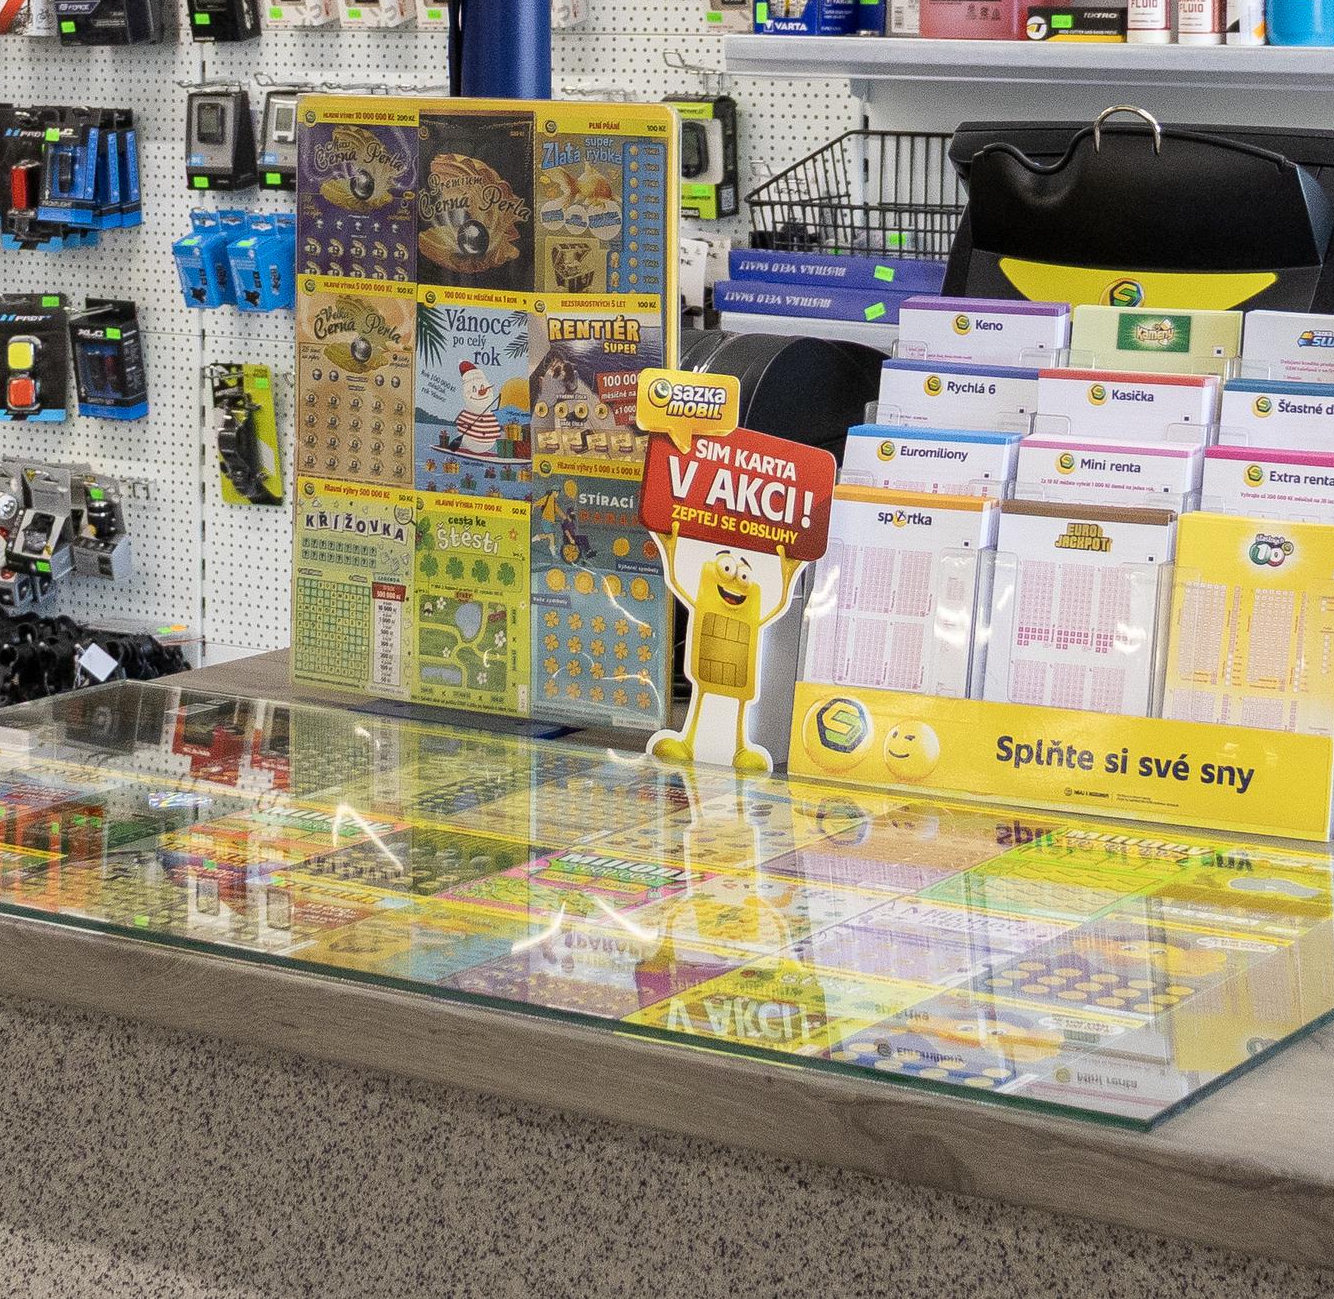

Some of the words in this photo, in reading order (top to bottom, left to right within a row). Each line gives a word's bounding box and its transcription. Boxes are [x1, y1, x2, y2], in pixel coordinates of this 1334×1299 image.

[1179, 3, 1204, 13] FLUID
[774, 22, 808, 31] VARTA
[363, 112, 374, 120] 000
[585, 139, 613, 148] super
[315, 144, 357, 172] Černá
[363, 142, 406, 171] Perla
[542, 142, 581, 170] Zlatá
[586, 150, 622, 164] rybka
[429, 173, 483, 195] Premium
[419, 189, 470, 220] Černá
[479, 185, 531, 222] Perla
[444, 291, 453, 299] 100
[454, 292, 467, 300] 000
[314, 315, 355, 339] Černá
[363, 313, 401, 343] Perla
[445, 308, 512, 335] Vánoce
[547, 314, 640, 342] RENTIÉR
[975, 319, 1003, 331] Keno
[1136, 324, 1175, 341] Kameny
[453, 337, 464, 347] po
[467, 335, 486, 349] celý
[603, 341, 636, 354] SUPER
[474, 349, 501, 366] rok
[603, 375, 621, 387] 100
[947, 381, 985, 395] Rychlá
[988, 384, 996, 394] 6
[671, 385, 726, 403] sazka
[1112, 389, 1154, 402] Kasička
[667, 400, 722, 420] MOBIL
[1278, 399, 1322, 415] Šťastné
[695, 439, 731, 465] SIM
[735, 450, 797, 481] KARTA
[900, 446, 968, 463] Euromiliony
[557, 462, 576, 470] Hlavní
[577, 464, 593, 474] výhry
[598, 465, 611, 473] 000
[621, 466, 633, 475] 000
[1081, 458, 1107, 470] Mini
[1110, 461, 1141, 473] renta
[1269, 471, 1301, 484] Extra
[324, 484, 341, 493] Hlavní
[342, 486, 359, 497] výhry
[359, 488, 370, 497] 500
[371, 489, 383, 498] 000
[668, 455, 699, 499] V
[705, 468, 796, 524] AKCI
[578, 492, 634, 508] STÍRACÍ
[305, 511, 405, 542] KŘÍŽOVKA
[448, 516, 473, 526] cesta
[476, 517, 486, 527] ke
[671, 504, 718, 527] ZEPTEJ
[721, 516, 737, 531] SE
[739, 520, 798, 545] OBSLUHY
[436, 522, 502, 554] Štěstí
[1068, 523, 1103, 537] EURO
[1055, 535, 1112, 552] JACKPOT
[996, 735, 1094, 771] Splňte
[1104, 747, 1128, 773] si
[1138, 754, 1189, 781] své
[1200, 762, 1255, 794] sny
